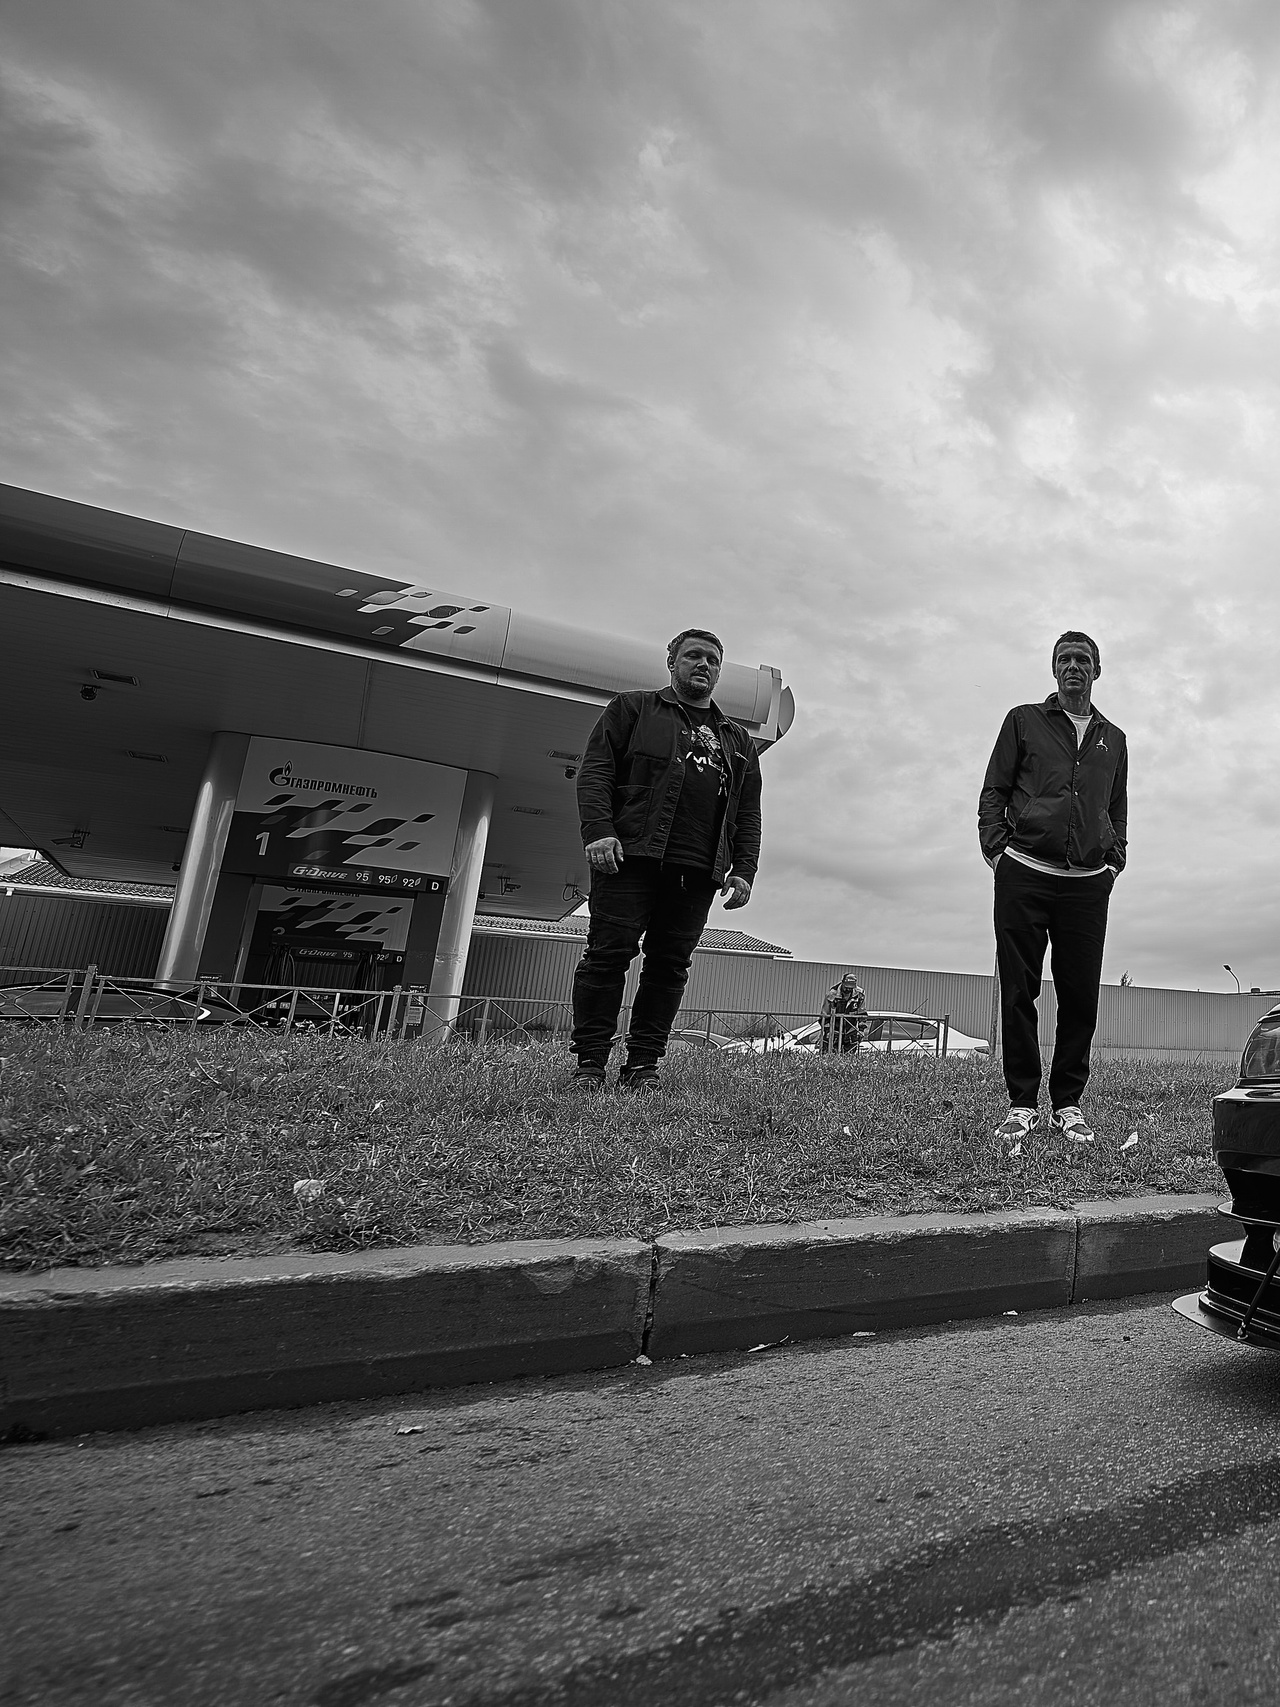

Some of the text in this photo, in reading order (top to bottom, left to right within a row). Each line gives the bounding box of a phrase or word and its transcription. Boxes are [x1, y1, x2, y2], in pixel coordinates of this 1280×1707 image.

[290, 777, 378, 799] ГАЗПРОМНЕФТЬ
[255, 831, 270, 856] 1
[356, 872, 370, 882] 95
[431, 881, 440, 891] D
